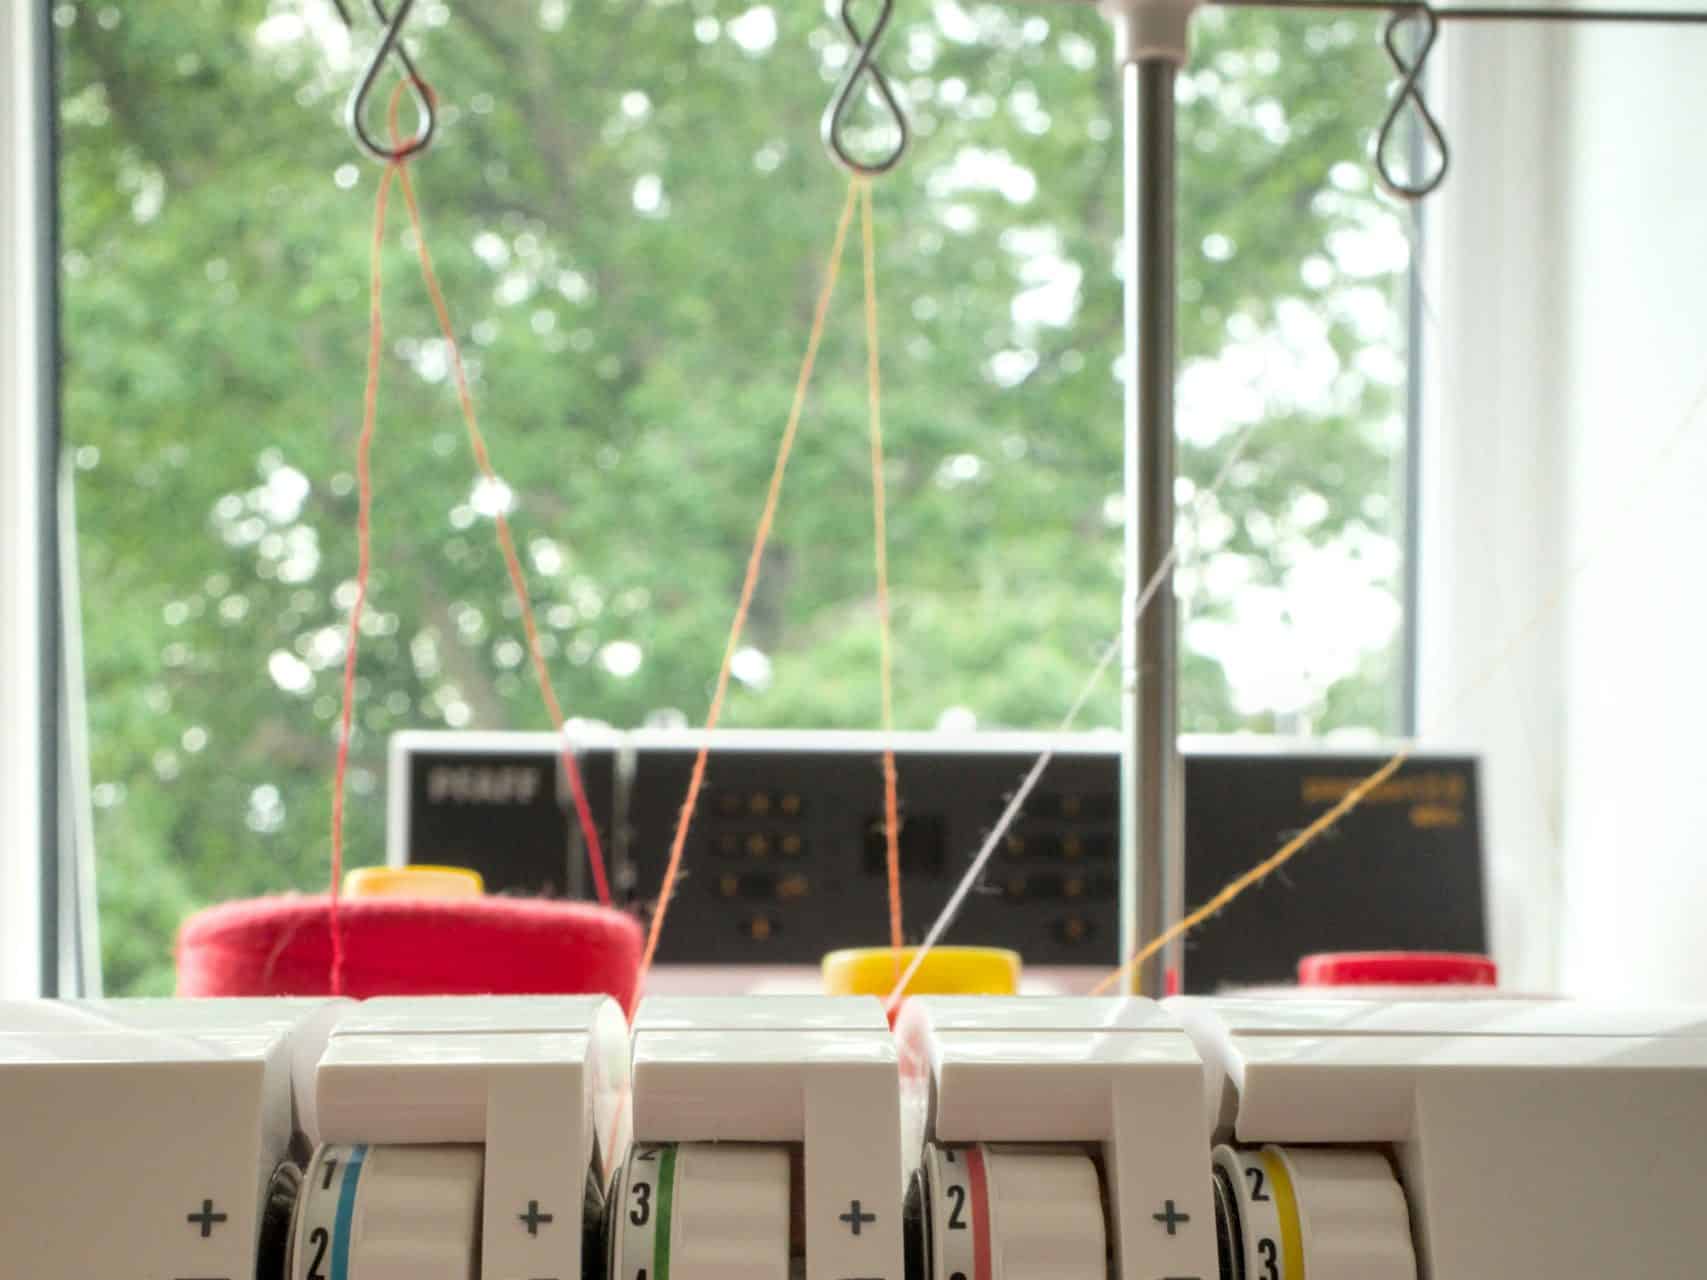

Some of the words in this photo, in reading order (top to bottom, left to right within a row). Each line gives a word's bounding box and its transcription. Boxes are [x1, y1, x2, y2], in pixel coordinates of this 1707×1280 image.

[321, 1159, 338, 1190] 1
[1245, 1168, 1269, 1200] 2
[630, 1182, 650, 1226] 3
[947, 1185, 967, 1229] 2
